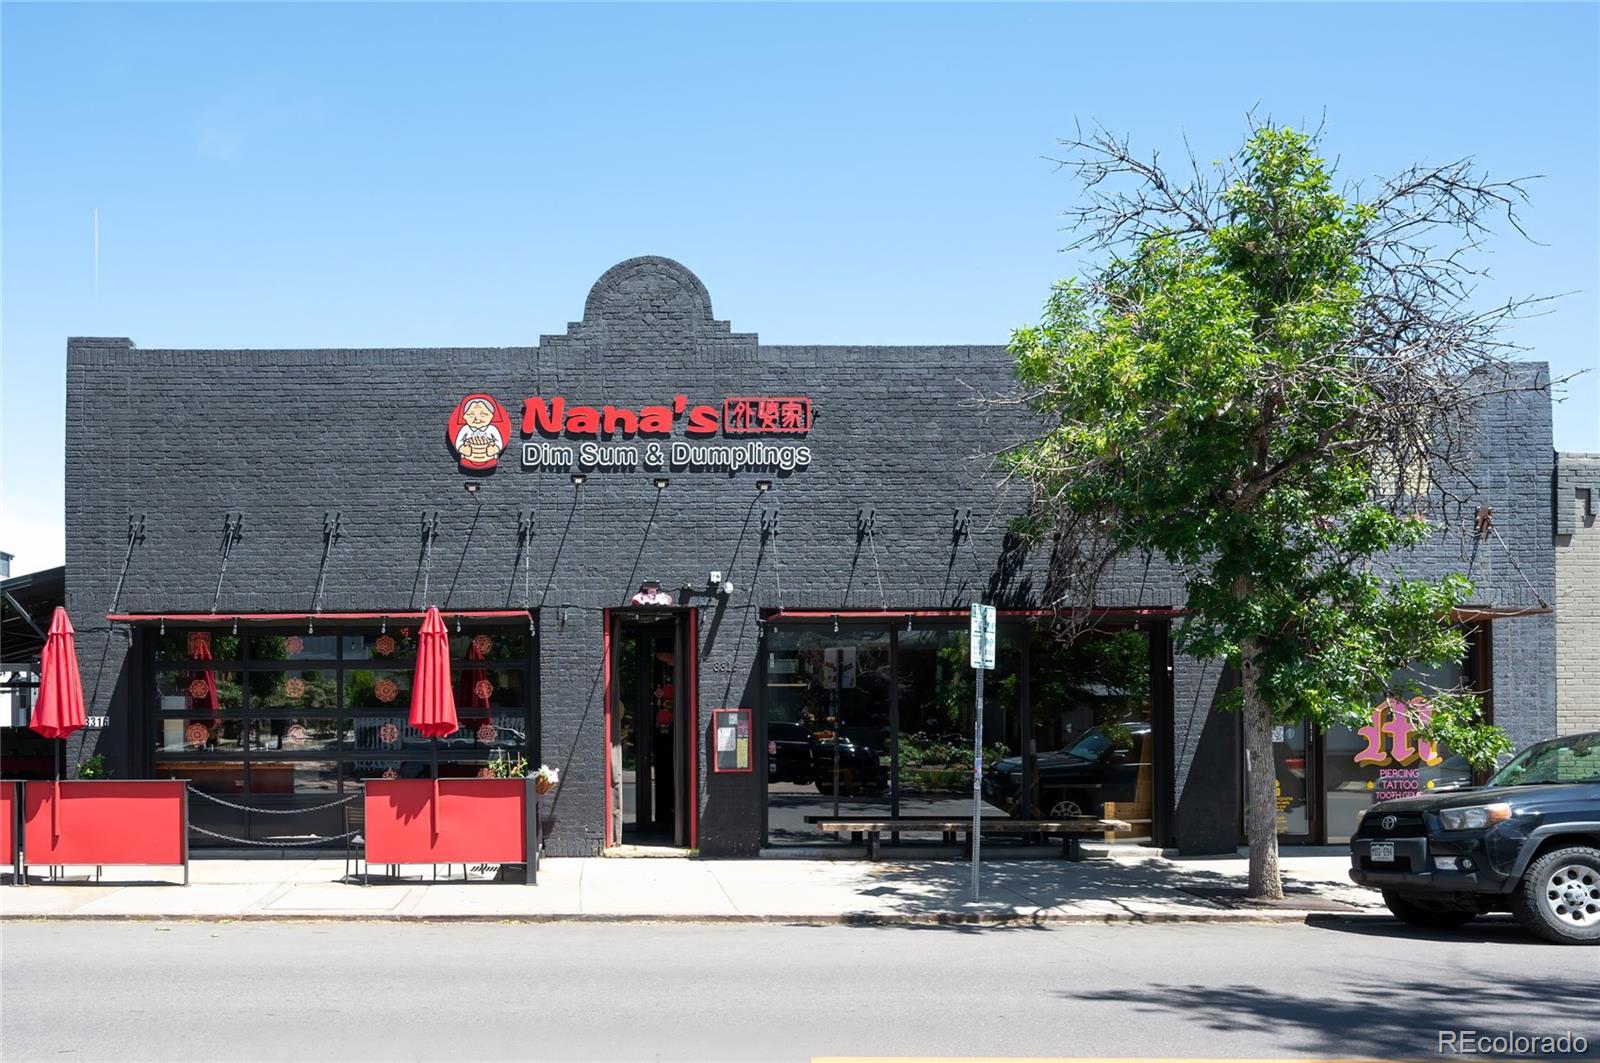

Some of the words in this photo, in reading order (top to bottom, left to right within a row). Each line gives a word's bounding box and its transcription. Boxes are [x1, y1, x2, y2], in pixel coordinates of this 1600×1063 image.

[522, 395, 720, 434] Nana's
[522, 442, 573, 465] Dim
[580, 442, 638, 465] Sum
[645, 442, 664, 466] &
[671, 442, 811, 470] Dumplings
[1380, 768, 1420, 779] PIERCING
[1381, 780, 1419, 790] TATTOO
[1375, 791, 1402, 800] TOOTH
